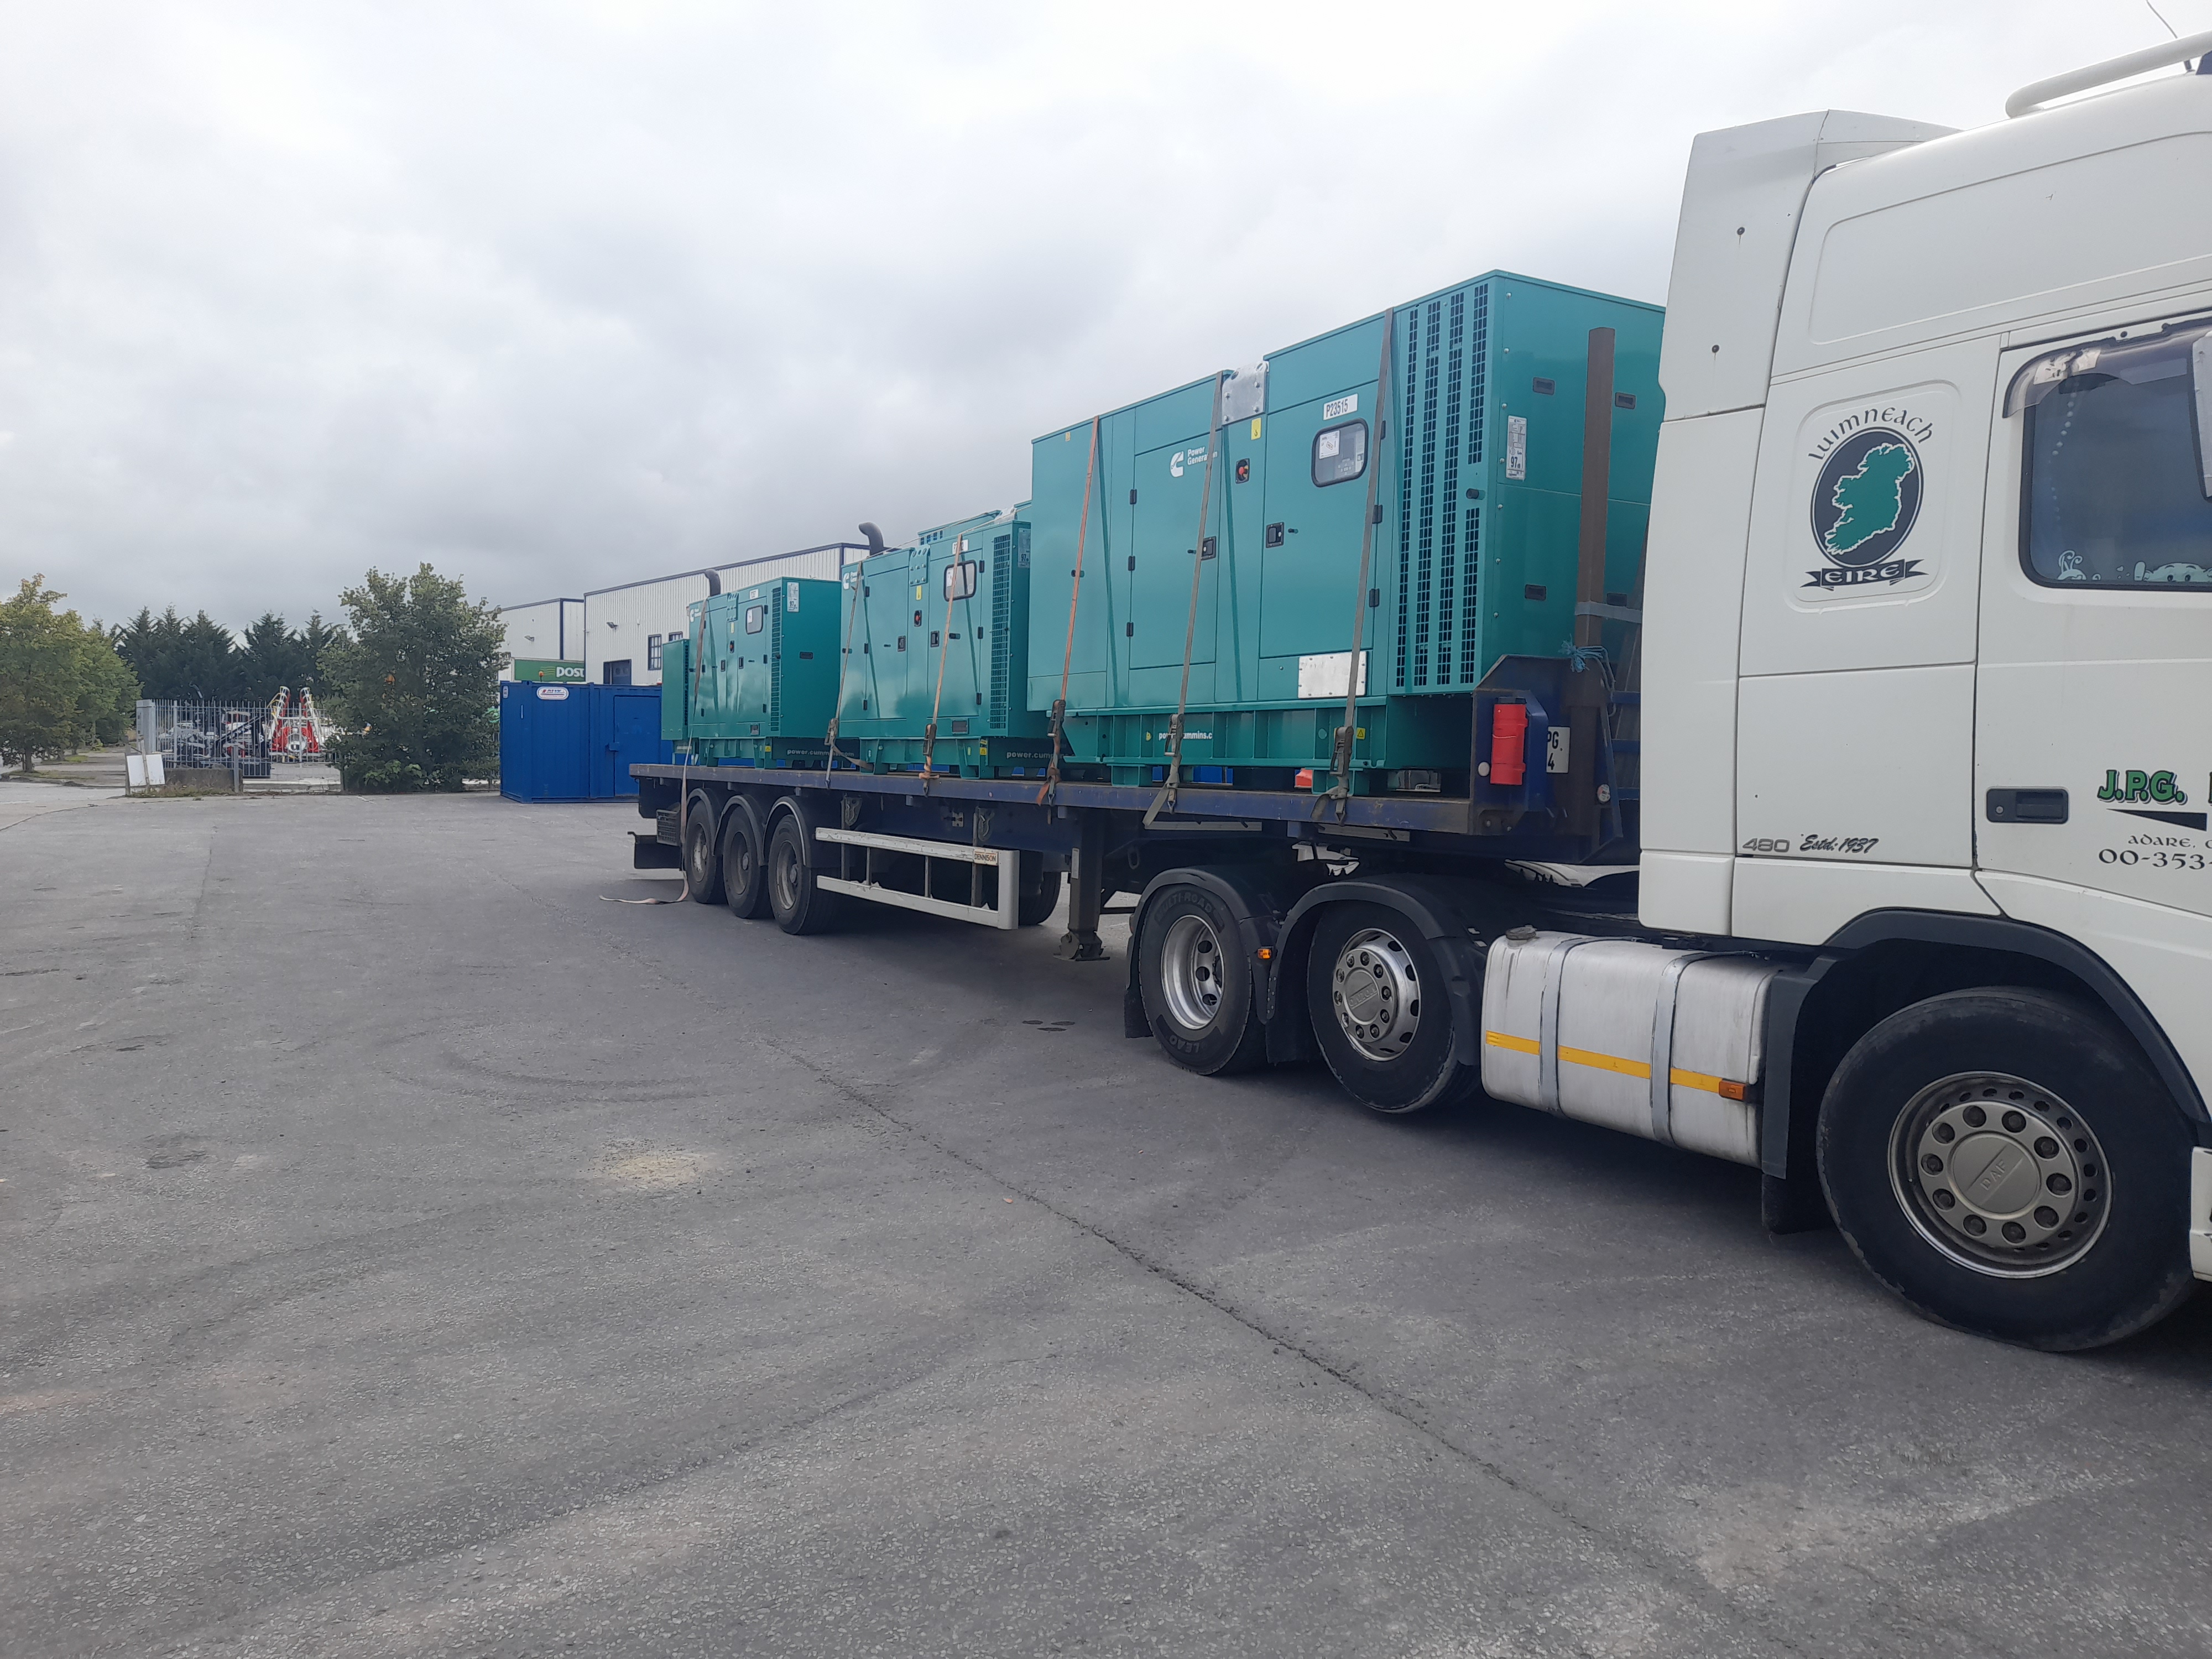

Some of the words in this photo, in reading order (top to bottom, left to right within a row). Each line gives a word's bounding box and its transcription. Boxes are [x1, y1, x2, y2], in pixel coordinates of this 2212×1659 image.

[1326, 399, 1348, 418] P23515
[1187, 446, 1205, 457] Power
[1187, 451, 1218, 465] Generan
[1824, 564, 1901, 583] EIRE
[2097, 769, 2188, 806] J.P.G.
[1742, 838, 1790, 852] 480
[974, 853, 997, 862] DENNISON
[1980, 1160, 2005, 1191] DAF
